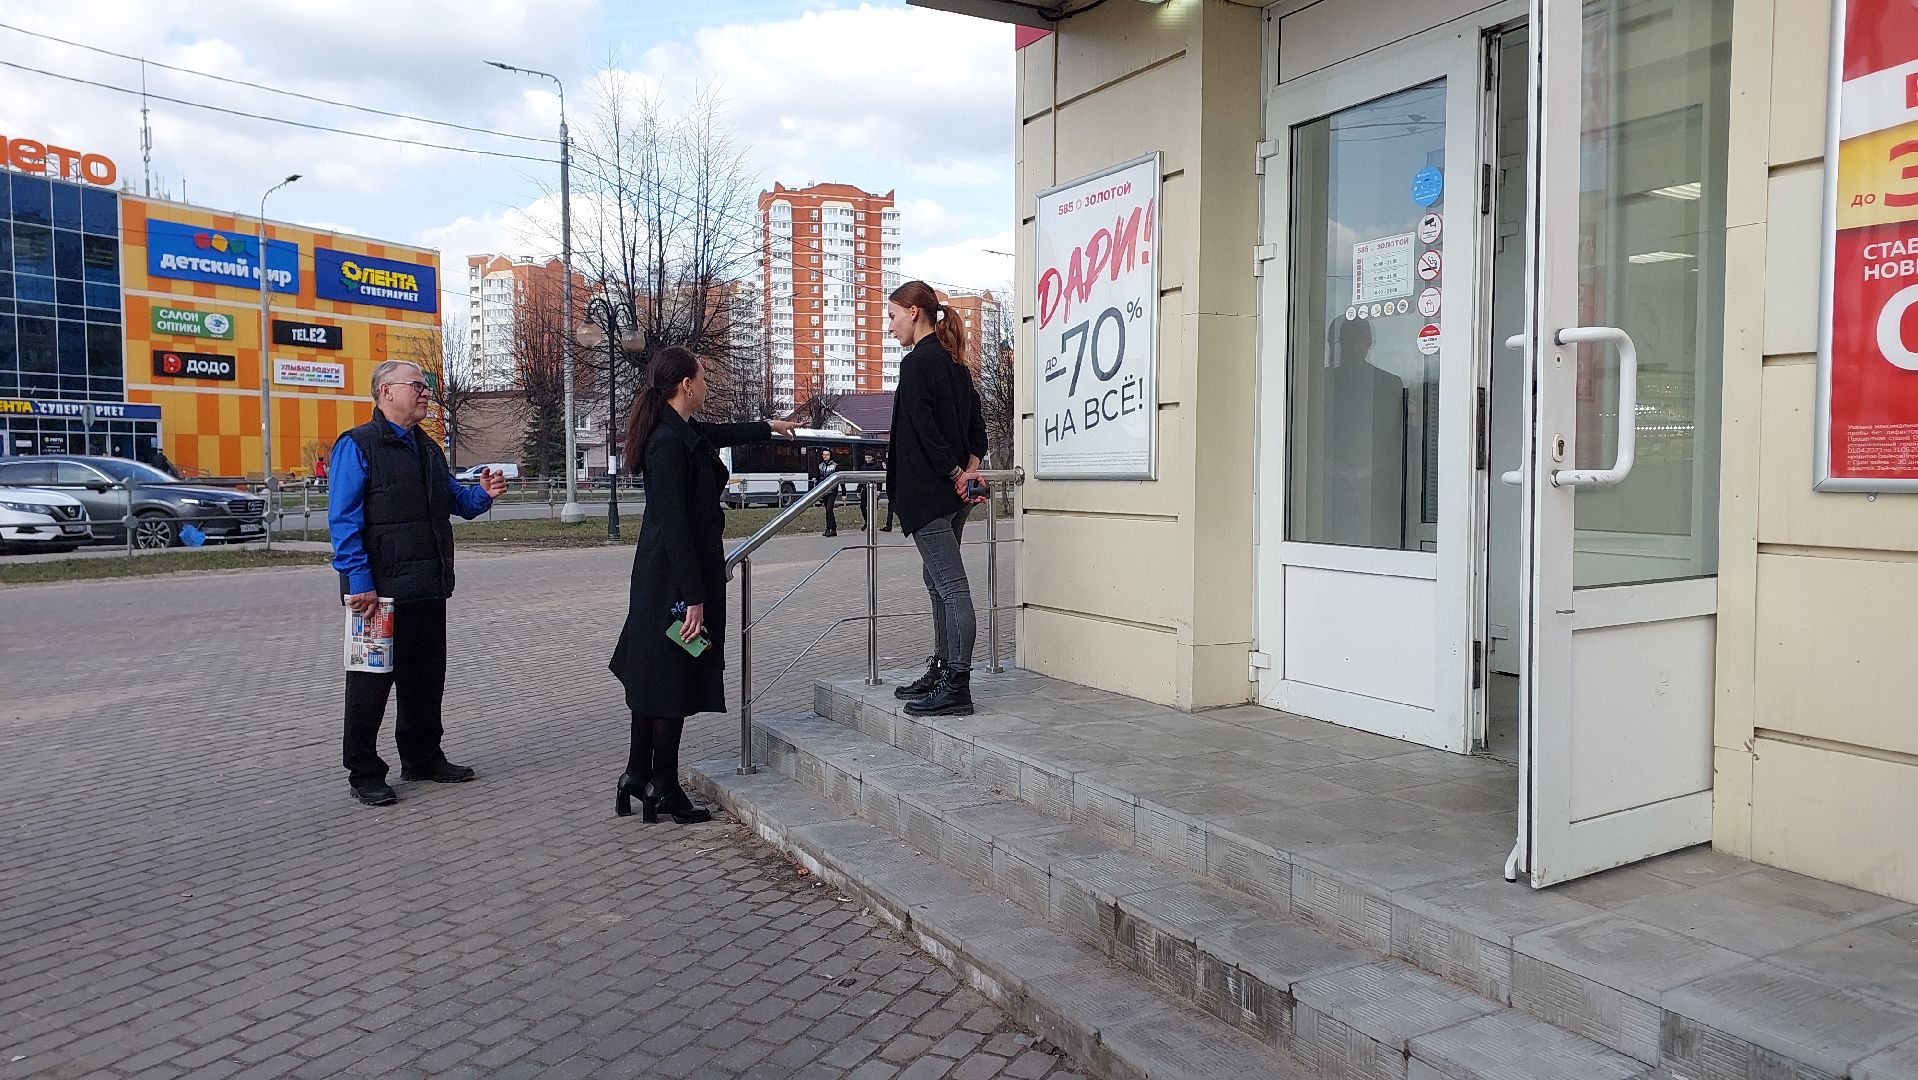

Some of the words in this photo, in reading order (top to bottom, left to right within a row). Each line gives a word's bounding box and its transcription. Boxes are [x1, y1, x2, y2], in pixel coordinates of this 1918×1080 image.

[1058, 201, 1074, 215] 585
[1084, 180, 1132, 208] ЗОЛОТОЙ
[1850, 193, 1876, 208] до
[1376, 236, 1409, 250] ЗОЛОТОЙ
[160, 253, 250, 279] детский
[1864, 258, 1918, 281] НОВ
[361, 267, 418, 291] ЛЕНТА
[360, 285, 419, 302] СУПЕРМАРКЕТ
[159, 309, 199, 322] САЛОН
[156, 320, 201, 334] ОПТИКИ
[291, 327, 327, 344] TELE2
[186, 359, 230, 376] ДОДО
[39, 402, 124, 417] СУПЕРРКЕТ
[1045, 408, 1076, 446] НА
[1084, 374, 1143, 430] ВСЁ!
